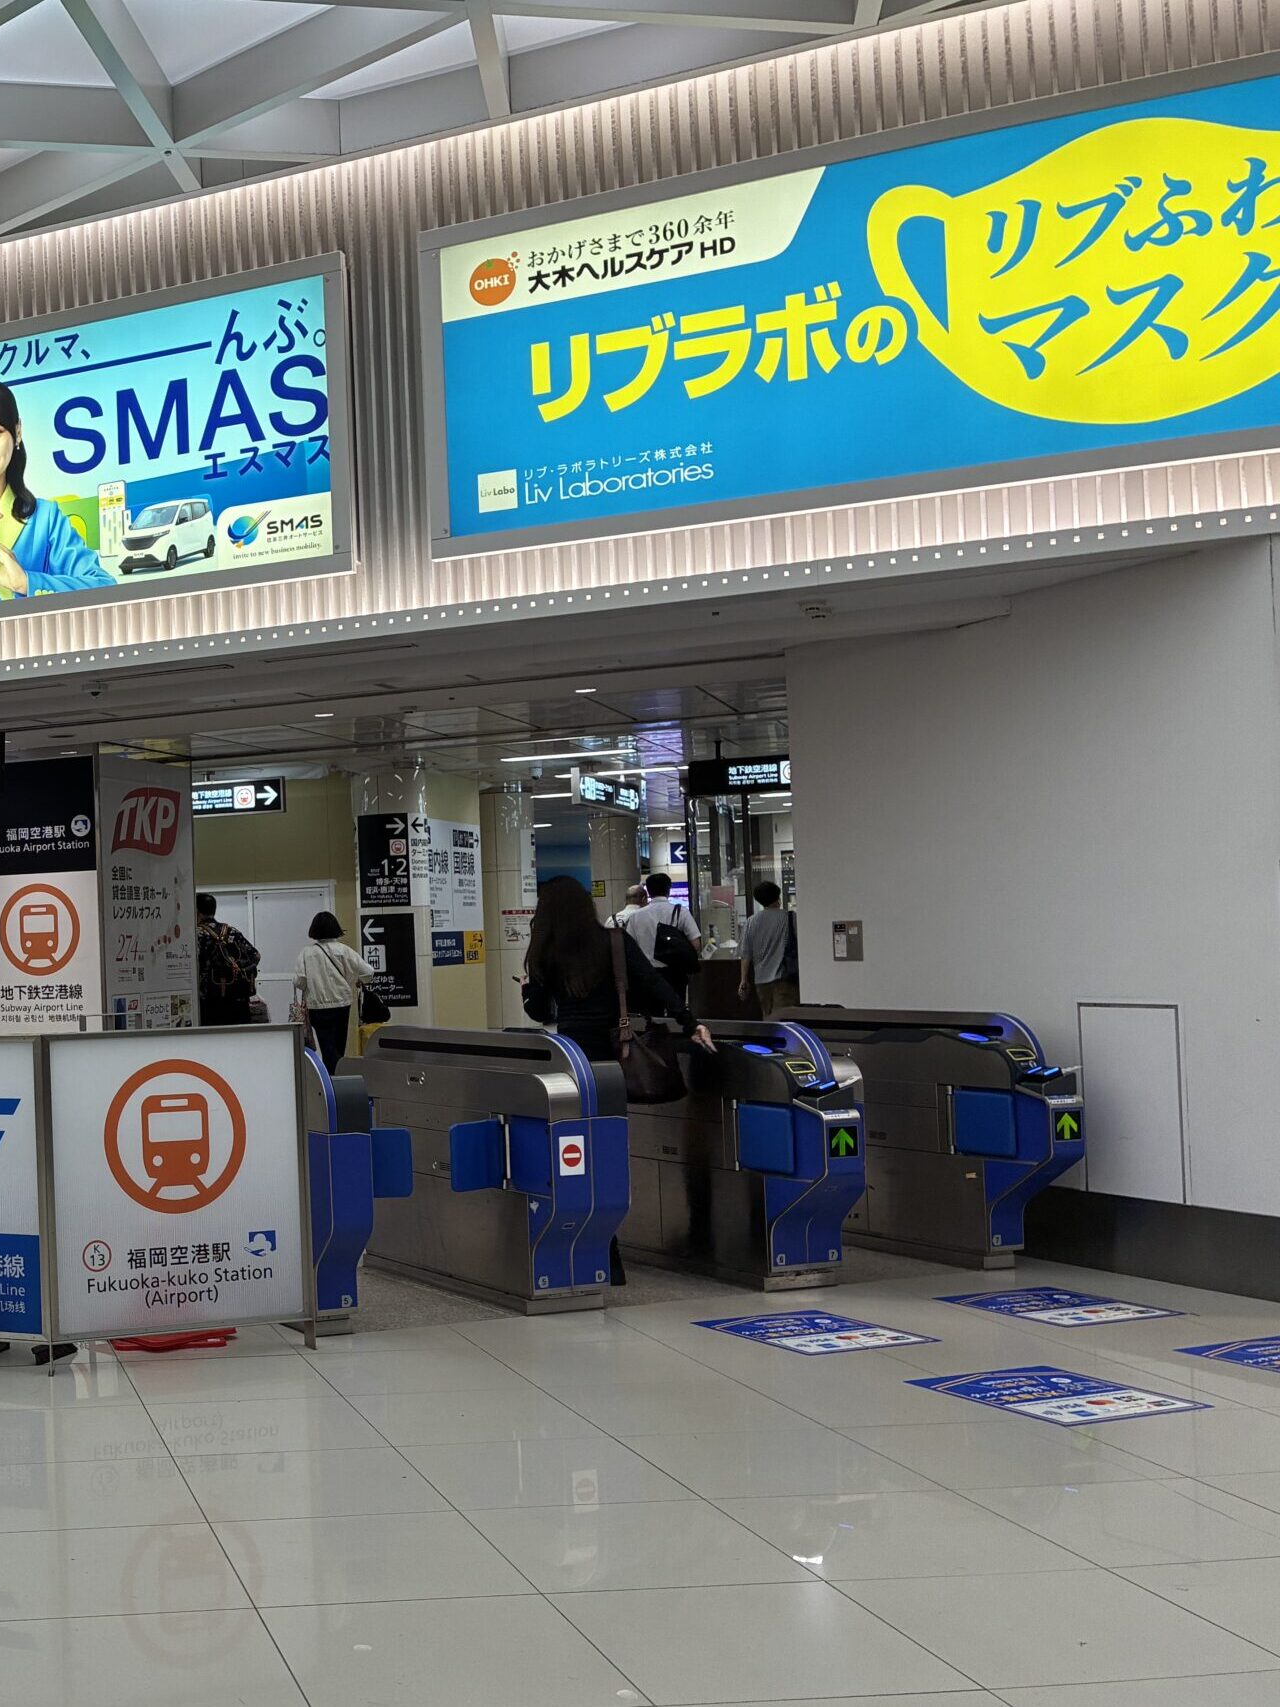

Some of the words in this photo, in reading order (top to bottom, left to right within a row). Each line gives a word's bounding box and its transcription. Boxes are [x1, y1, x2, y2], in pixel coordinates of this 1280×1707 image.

[528, 210, 735, 268] おかげさまで360余年
[528, 241, 694, 294] 大木ヘルスケア
[700, 236, 736, 259] HD
[474, 273, 510, 292] OHKI
[978, 251, 1280, 381] マスク
[531, 282, 908, 423] リブラボの
[52, 354, 329, 475] SMAS
[203, 434, 330, 480] エスマス
[524, 442, 714, 481] リブ・ラボラトリーズ株式会社
[493, 486, 516, 497] Labo
[525, 482, 553, 505] Liv
[559, 462, 715, 500] Laboratories
[266, 514, 323, 535] SMAS
[270, 546, 295, 555] business
[295, 542, 322, 553] mobility.
[120, 796, 176, 845] TKP
[6, 825, 66, 841] 福岡空港駅
[23, 842, 56, 854] Airport
[58, 840, 90, 850] Station
[111, 865, 133, 881] 全国に
[112, 905, 162, 920] レンタルオフィス
[0, 984, 84, 1001] 地下鉄空港線
[0, 1003, 32, 1013] Subway
[33, 1003, 64, 1013] Airport
[66, 1002, 84, 1012] Line
[90, 1253, 106, 1268] 13
[127, 1242, 232, 1270] 福岡空港駅
[0, 1283, 26, 1297] Line
[87, 1271, 209, 1294] Fukuoka-kuko
[214, 1264, 274, 1283] Station
[145, 1285, 219, 1309] (Airport)
